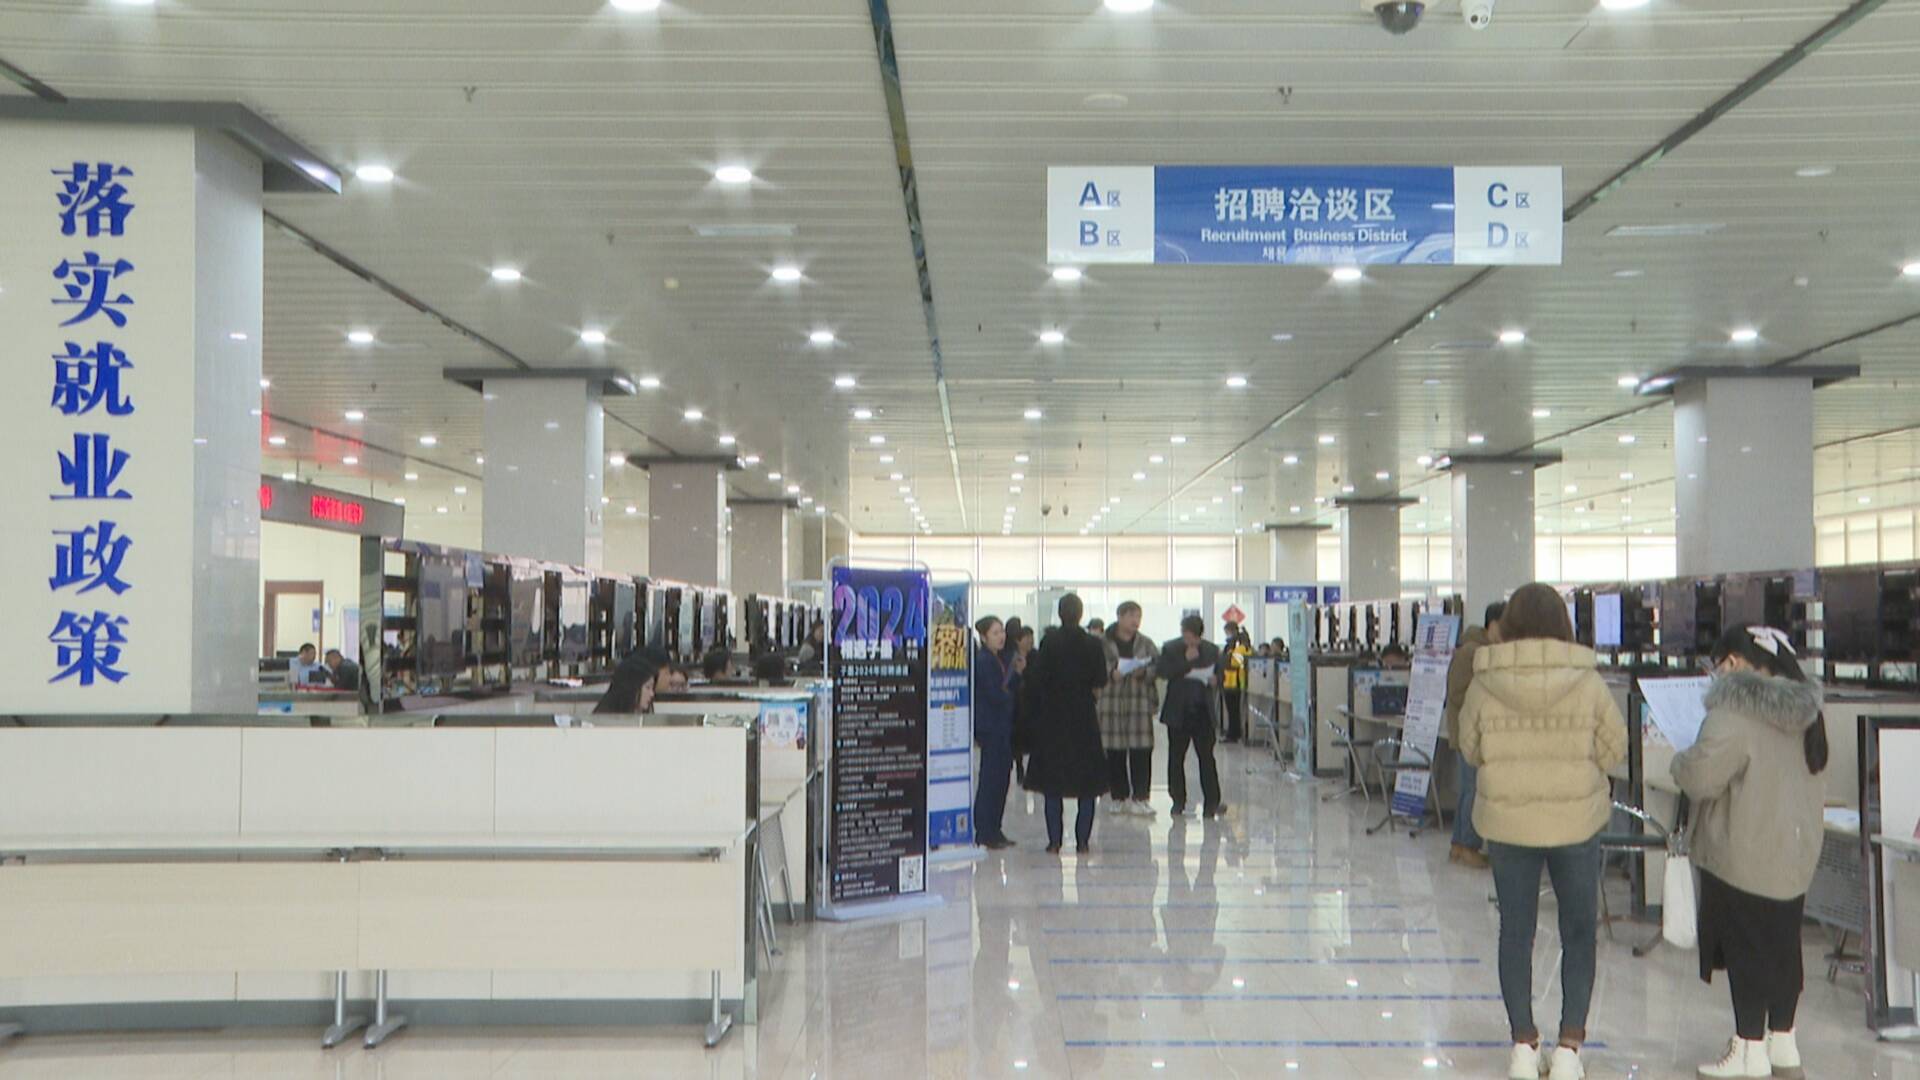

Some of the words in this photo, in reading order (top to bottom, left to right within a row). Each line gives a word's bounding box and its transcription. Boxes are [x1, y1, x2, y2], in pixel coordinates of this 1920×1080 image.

[1079, 181, 1121, 208] A区
[1214, 187, 1396, 222] 招聘洽谈区
[1487, 182, 1530, 209] C区
[1079, 220, 1121, 247] B区
[1200, 227, 1286, 243] Recruitment
[1293, 227, 1355, 243] Business
[1358, 227, 1408, 243] District
[49, 161, 135, 686] 落实就业政策
[833, 584, 926, 649] 2024
